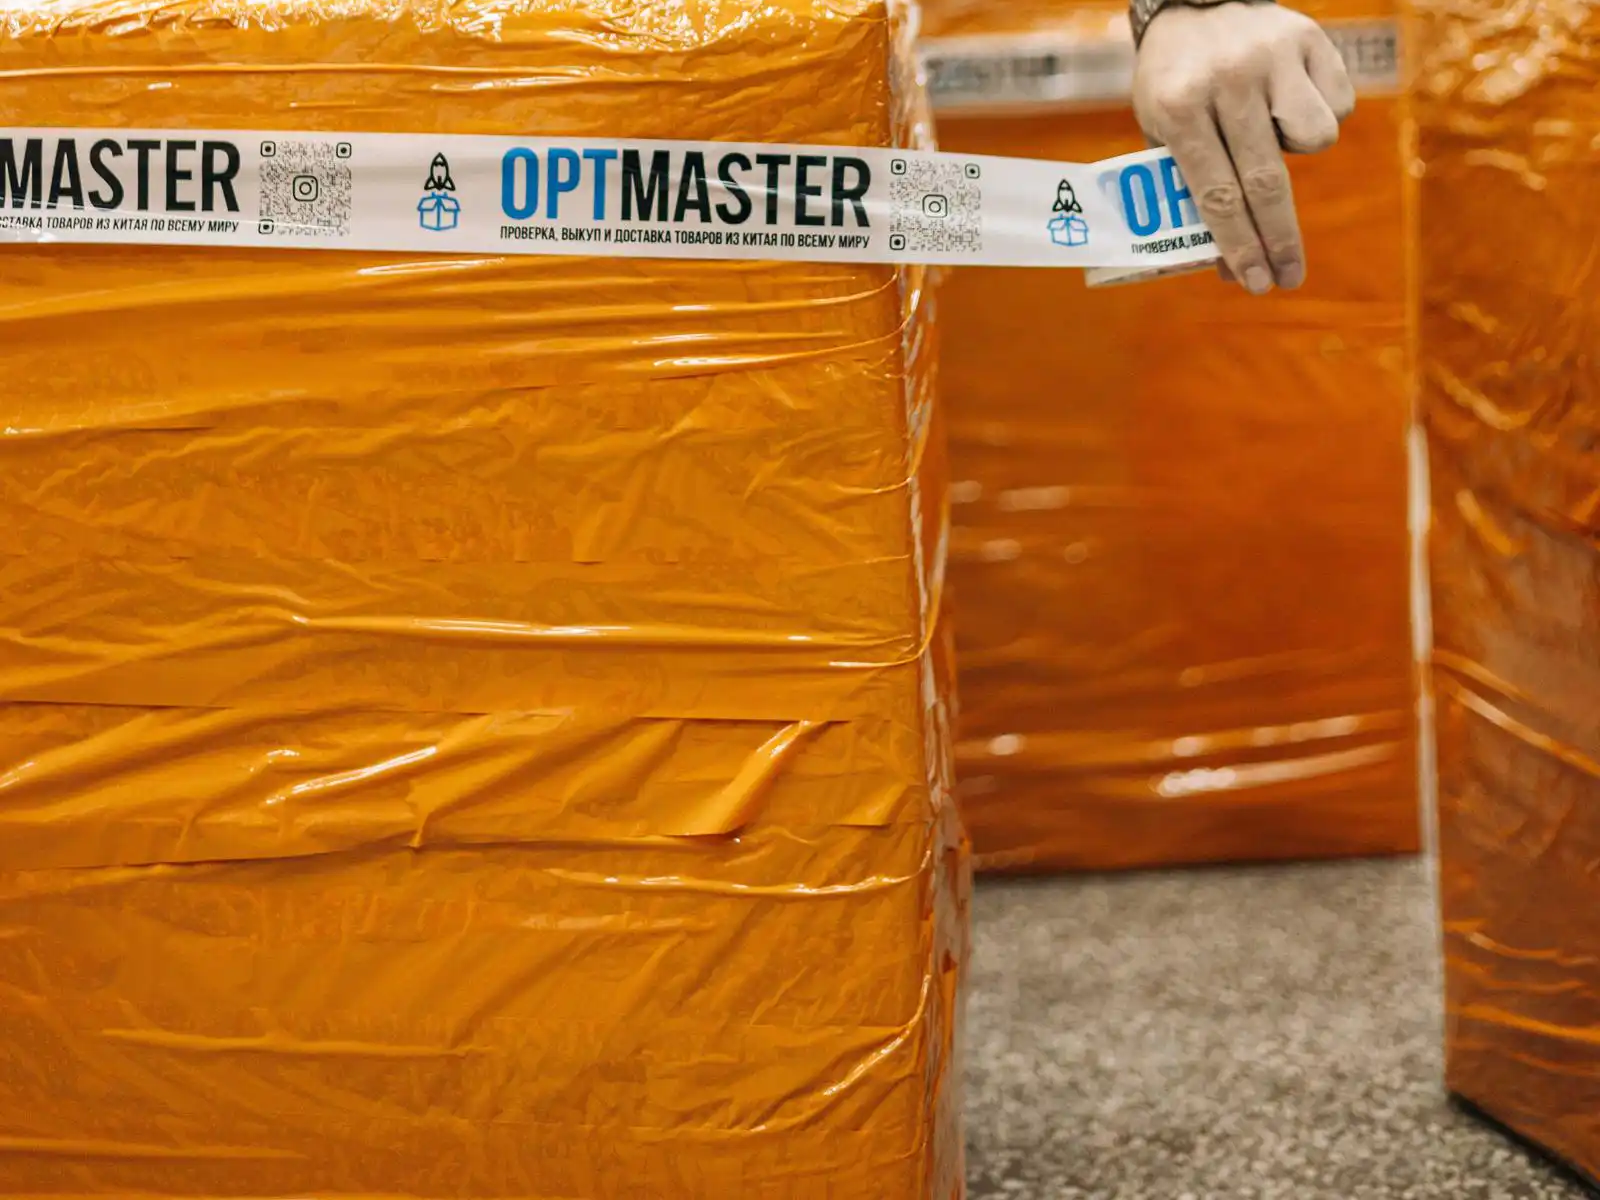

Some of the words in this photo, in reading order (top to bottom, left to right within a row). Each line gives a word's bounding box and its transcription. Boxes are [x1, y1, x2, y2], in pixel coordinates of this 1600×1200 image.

[0, 138, 240, 212] MASTER
[501, 147, 871, 228] OPTMASTER
[0, 216, 42, 229] СТАВКА
[47, 217, 93, 230] ТОВАРОВ
[96, 218, 110, 230] ИЗ
[113, 218, 147, 231] КИТАЯ
[151, 219, 165, 231] ПО
[167, 219, 205, 232] ВСЕМУ
[208, 220, 239, 233] МИРУ
[500, 226, 558, 241] ПРОВЕРКА,
[561, 227, 601, 241] ВЫКУП
[604, 228, 611, 242] И
[614, 229, 671, 244] ДОСТАВКА
[675, 230, 722, 245] ТОВАРОВ
[726, 232, 739, 245] ИЗ
[743, 232, 777, 246] КИТАЯ
[780, 233, 795, 246] ПО
[798, 234, 835, 248] ВСЕМУ
[839, 235, 870, 249] МИРУ
[1131, 235, 1189, 254] ПРОВЕРКА,
